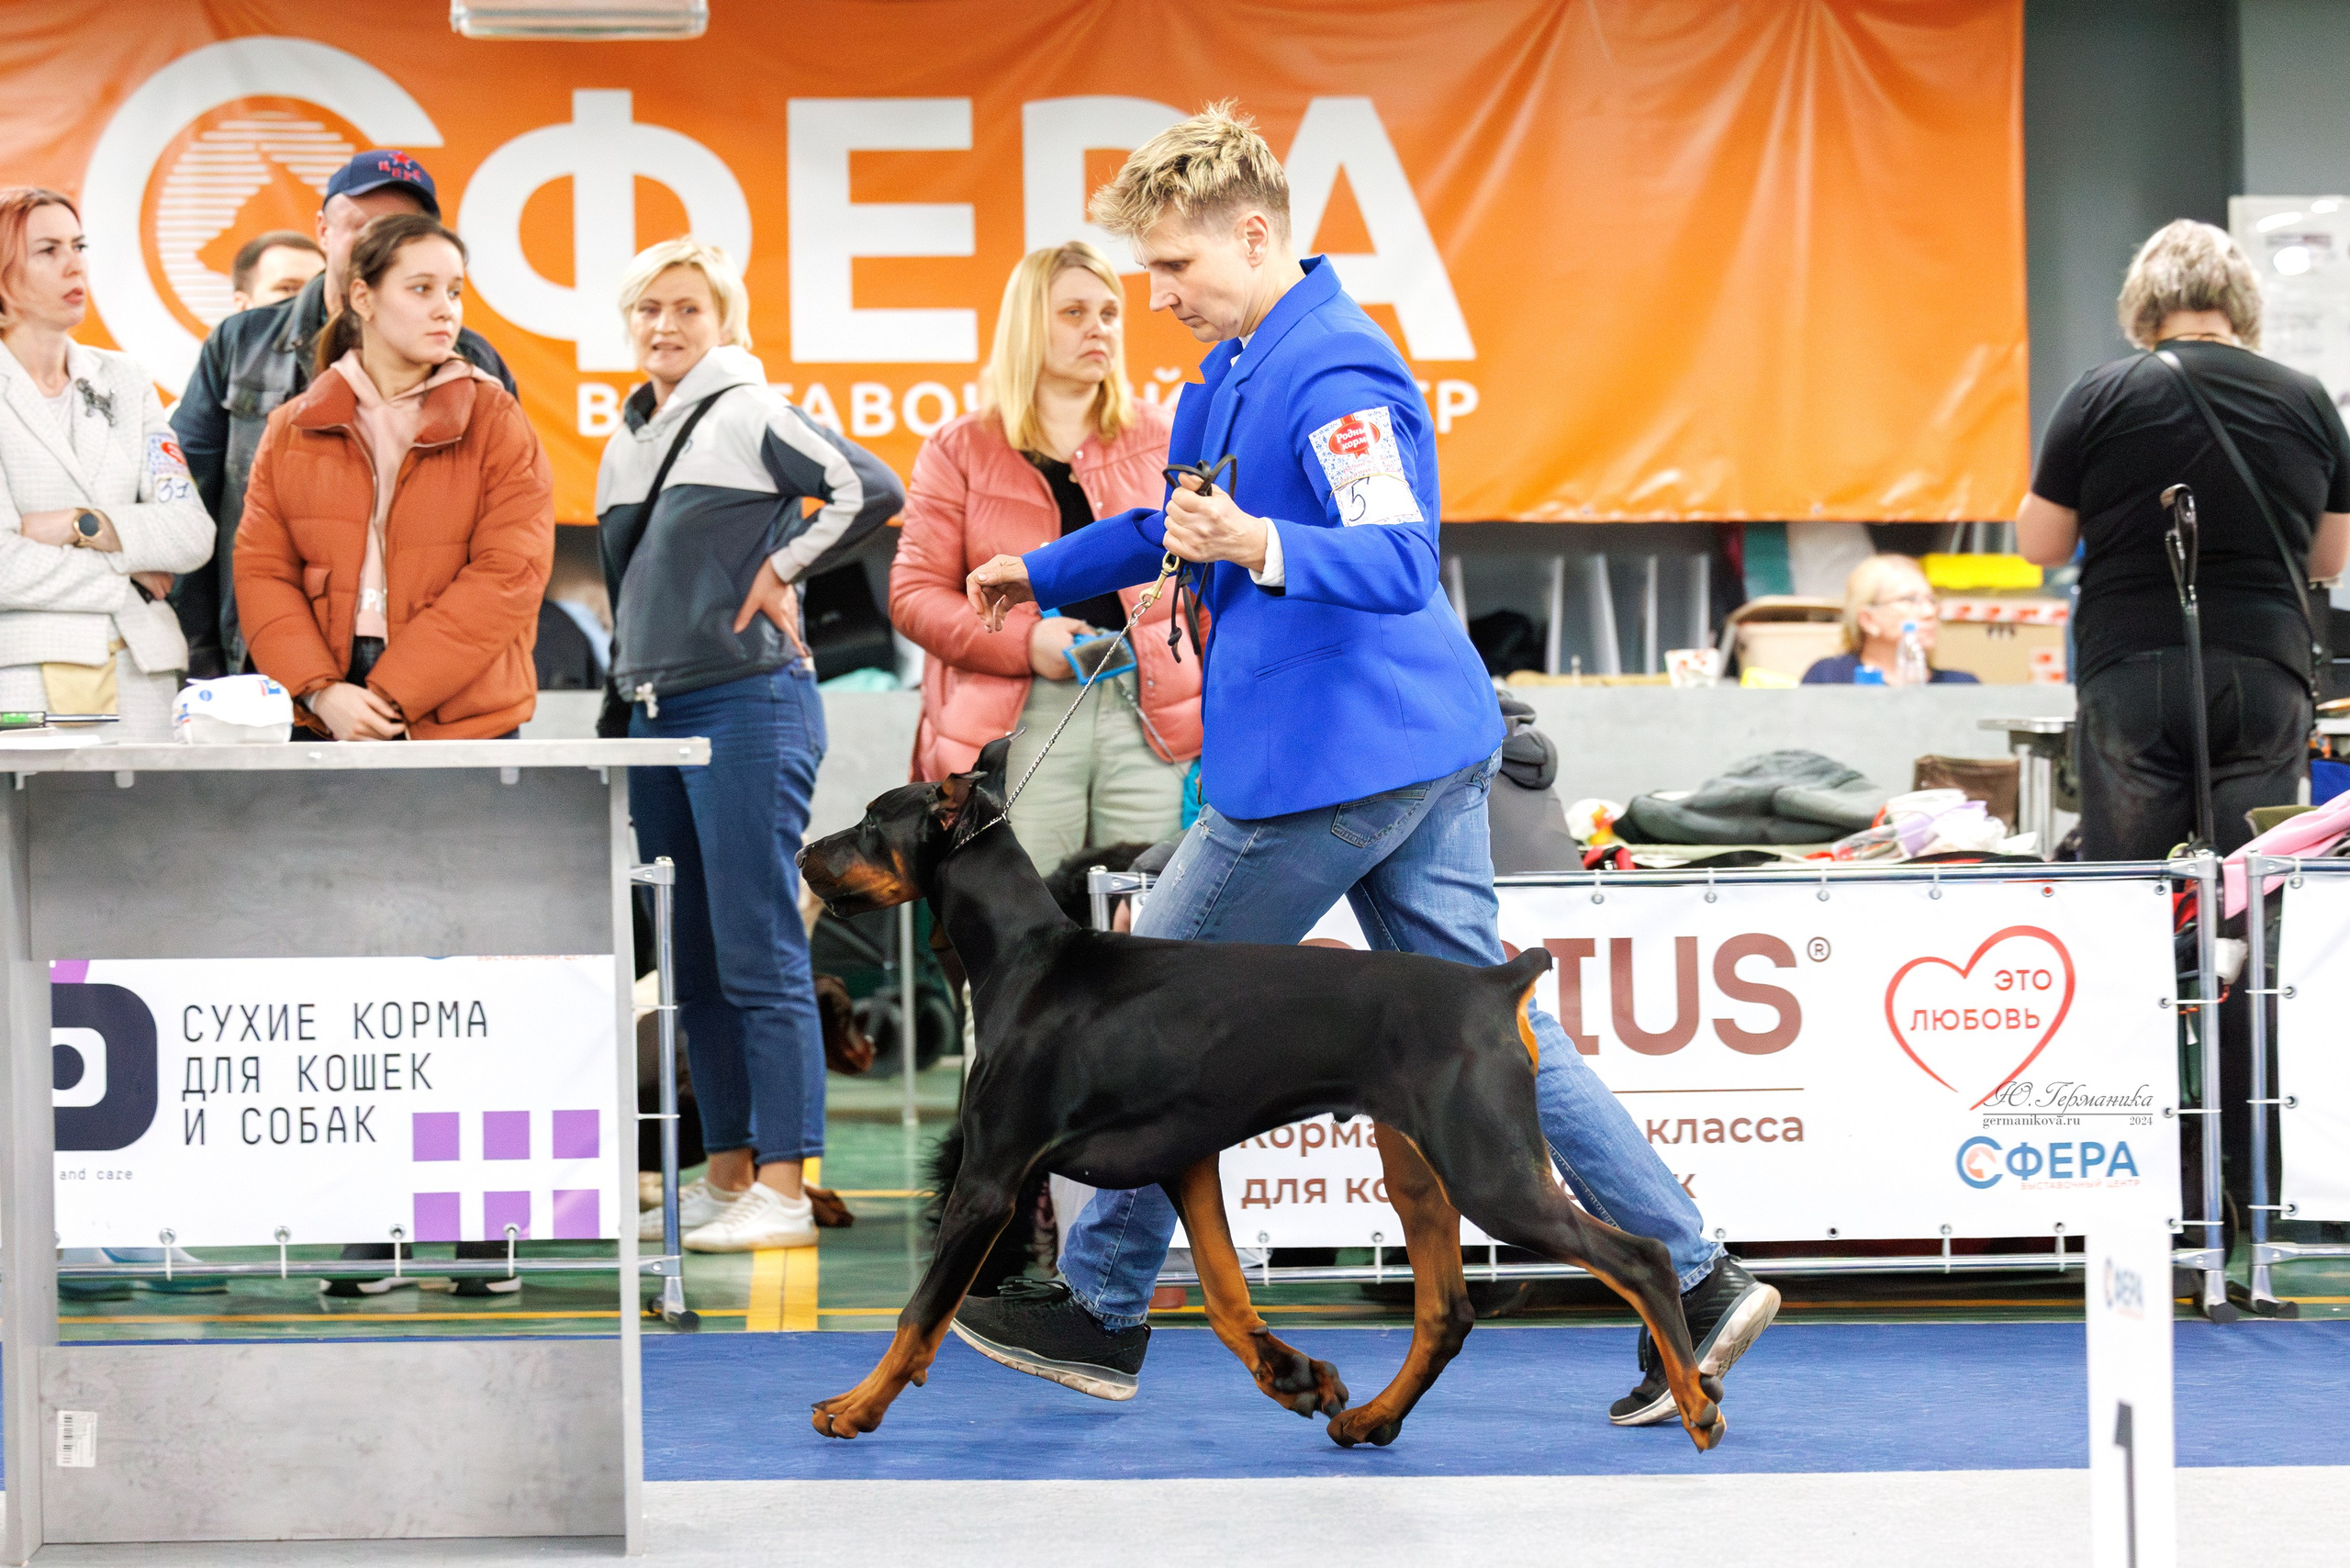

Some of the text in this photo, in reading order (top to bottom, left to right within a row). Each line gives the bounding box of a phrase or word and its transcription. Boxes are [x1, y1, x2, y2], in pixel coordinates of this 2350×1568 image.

[1336, 428, 1367, 444] Родны
[1341, 436, 1368, 451] корм
[1348, 476, 1371, 522] 5
[1994, 969, 2053, 991] ЭТО
[183, 1000, 488, 1043] СУХИЕ КОРМА
[1909, 1007, 2041, 1032] ЛЮБОВЬ
[181, 1052, 433, 1103] ДЛЯ КОШЕК
[185, 1104, 377, 1146] И СОБАК
[1646, 1116, 1805, 1145] класса
[60, 1168, 134, 1182] and care
[1955, 1136, 2141, 1190] СФЕРА
[1240, 1178, 1327, 1210] для
